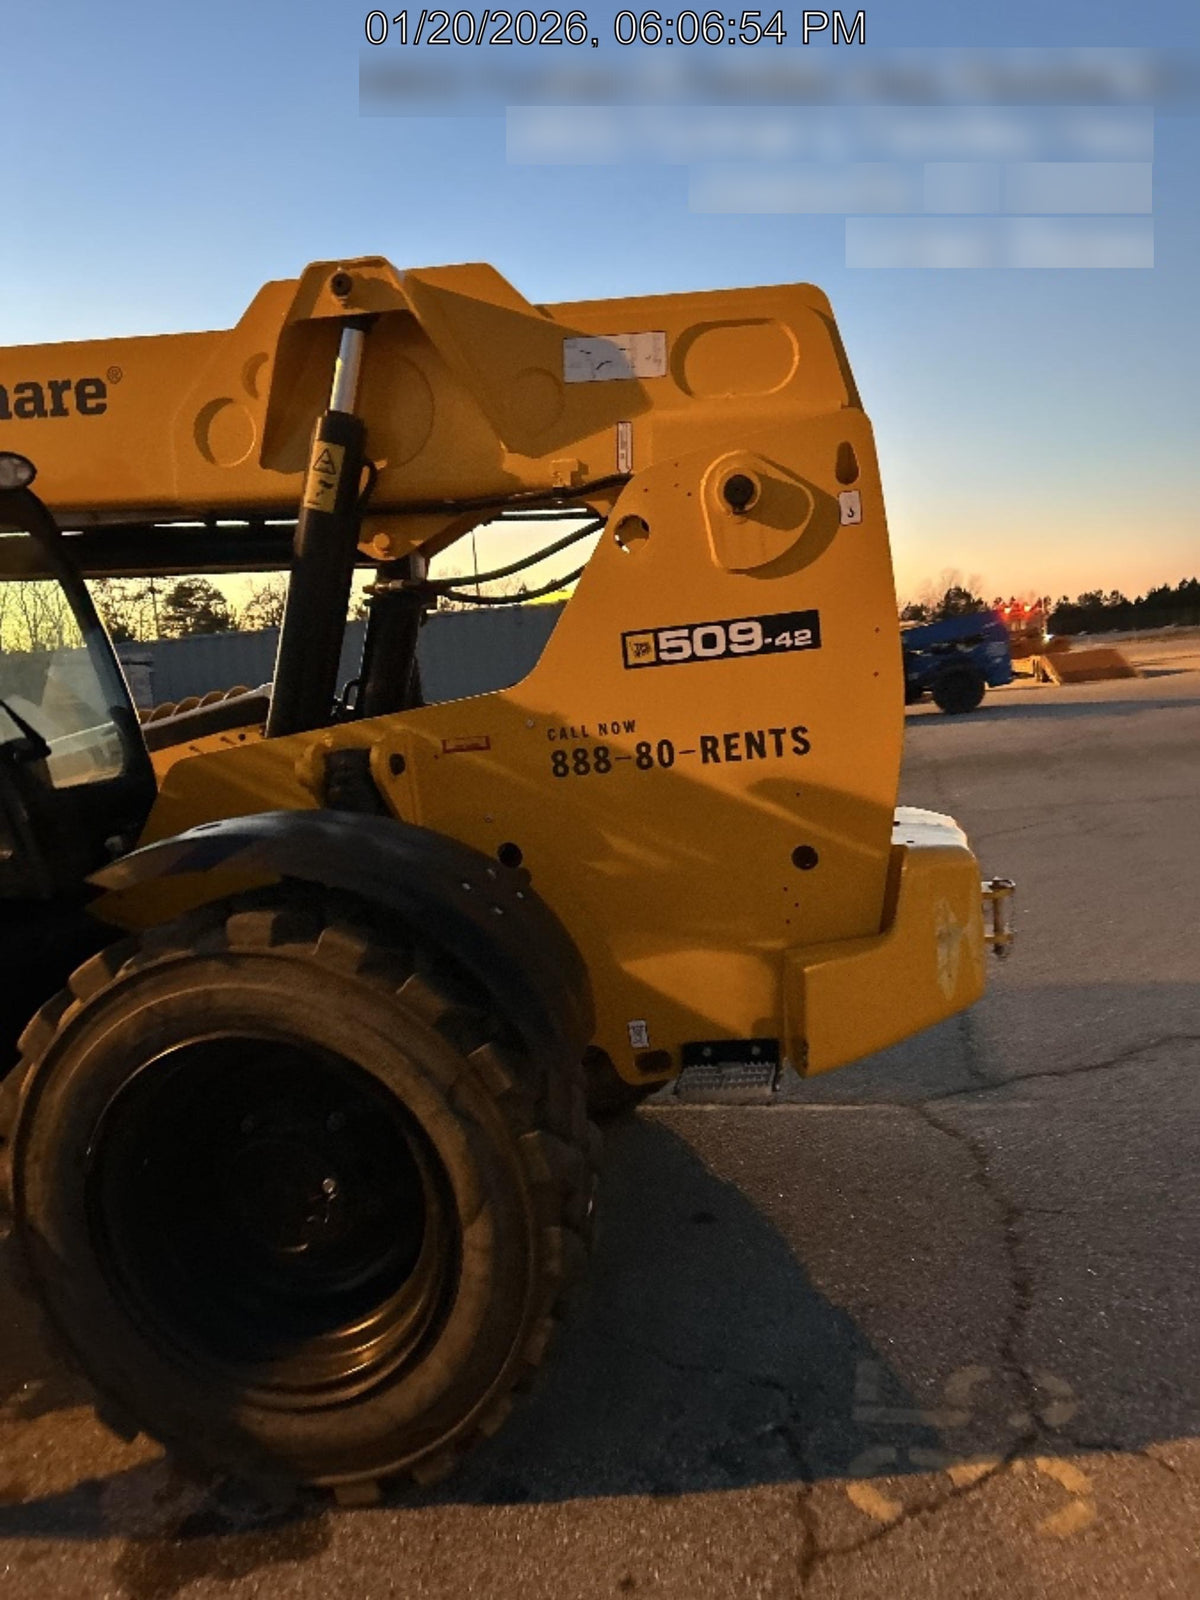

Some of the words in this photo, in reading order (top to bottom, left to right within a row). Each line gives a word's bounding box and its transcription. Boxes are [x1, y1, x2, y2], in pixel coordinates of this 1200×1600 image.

[547, 724, 589, 741] CALL
[598, 719, 636, 737] NOW
[550, 725, 811, 778] 888-80-RENTS
